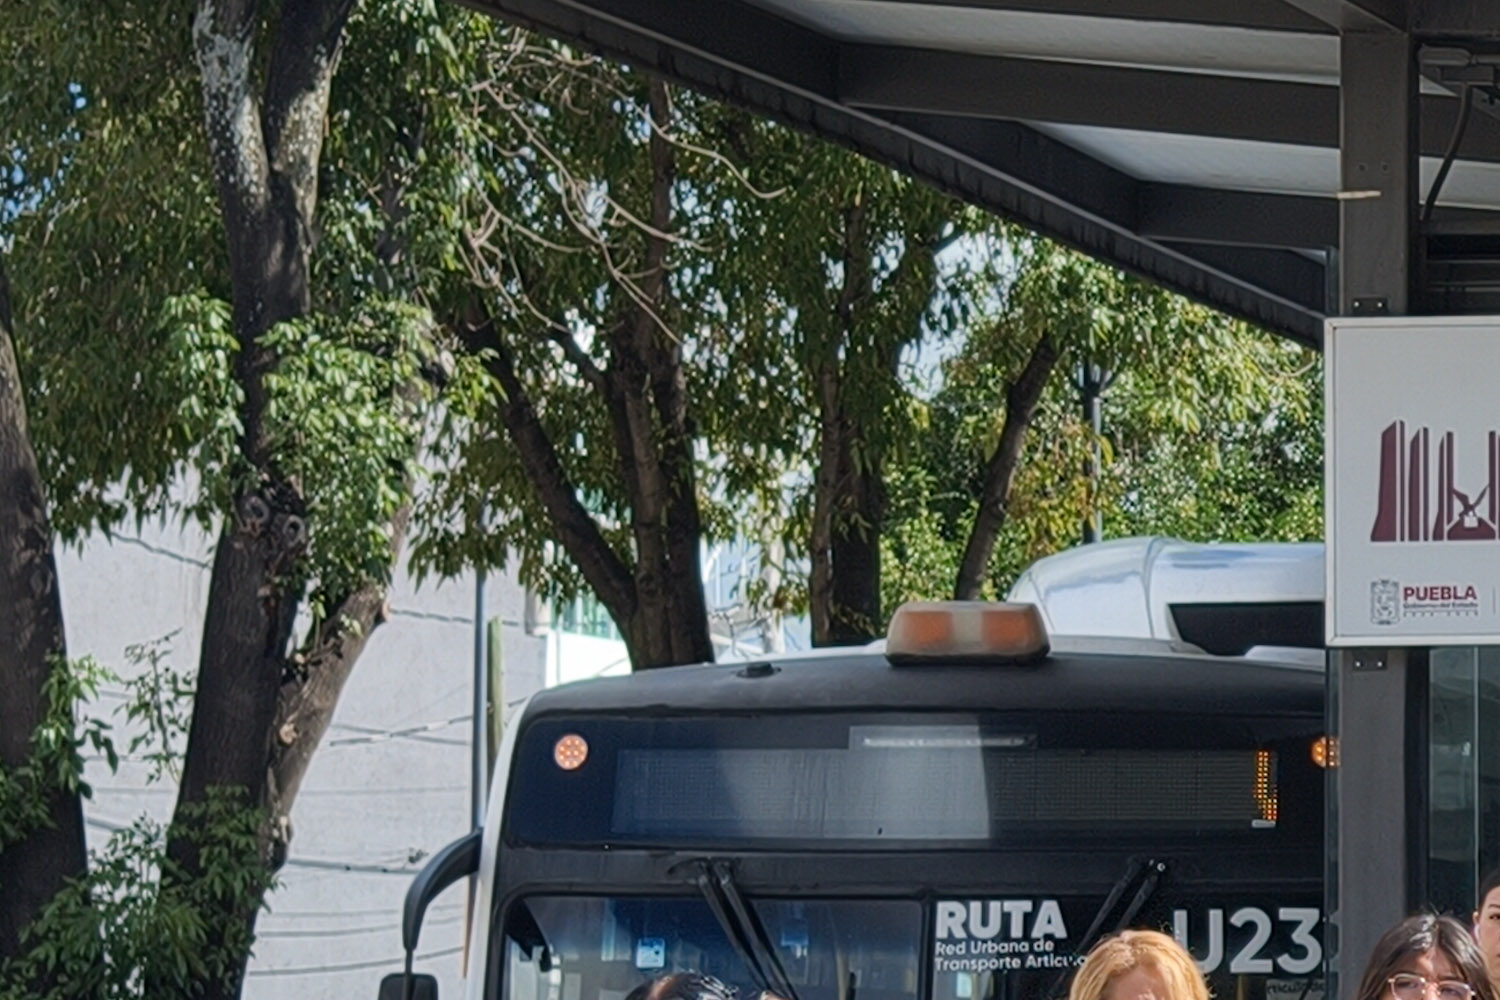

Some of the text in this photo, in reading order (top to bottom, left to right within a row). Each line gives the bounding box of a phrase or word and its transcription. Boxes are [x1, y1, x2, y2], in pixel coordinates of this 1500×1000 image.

[1403, 586, 1477, 601] PUEBLA
[936, 899, 1327, 975] RUTA U23
[936, 937, 1055, 957] Red Urbana de
[935, 955, 1022, 971] Transporte
